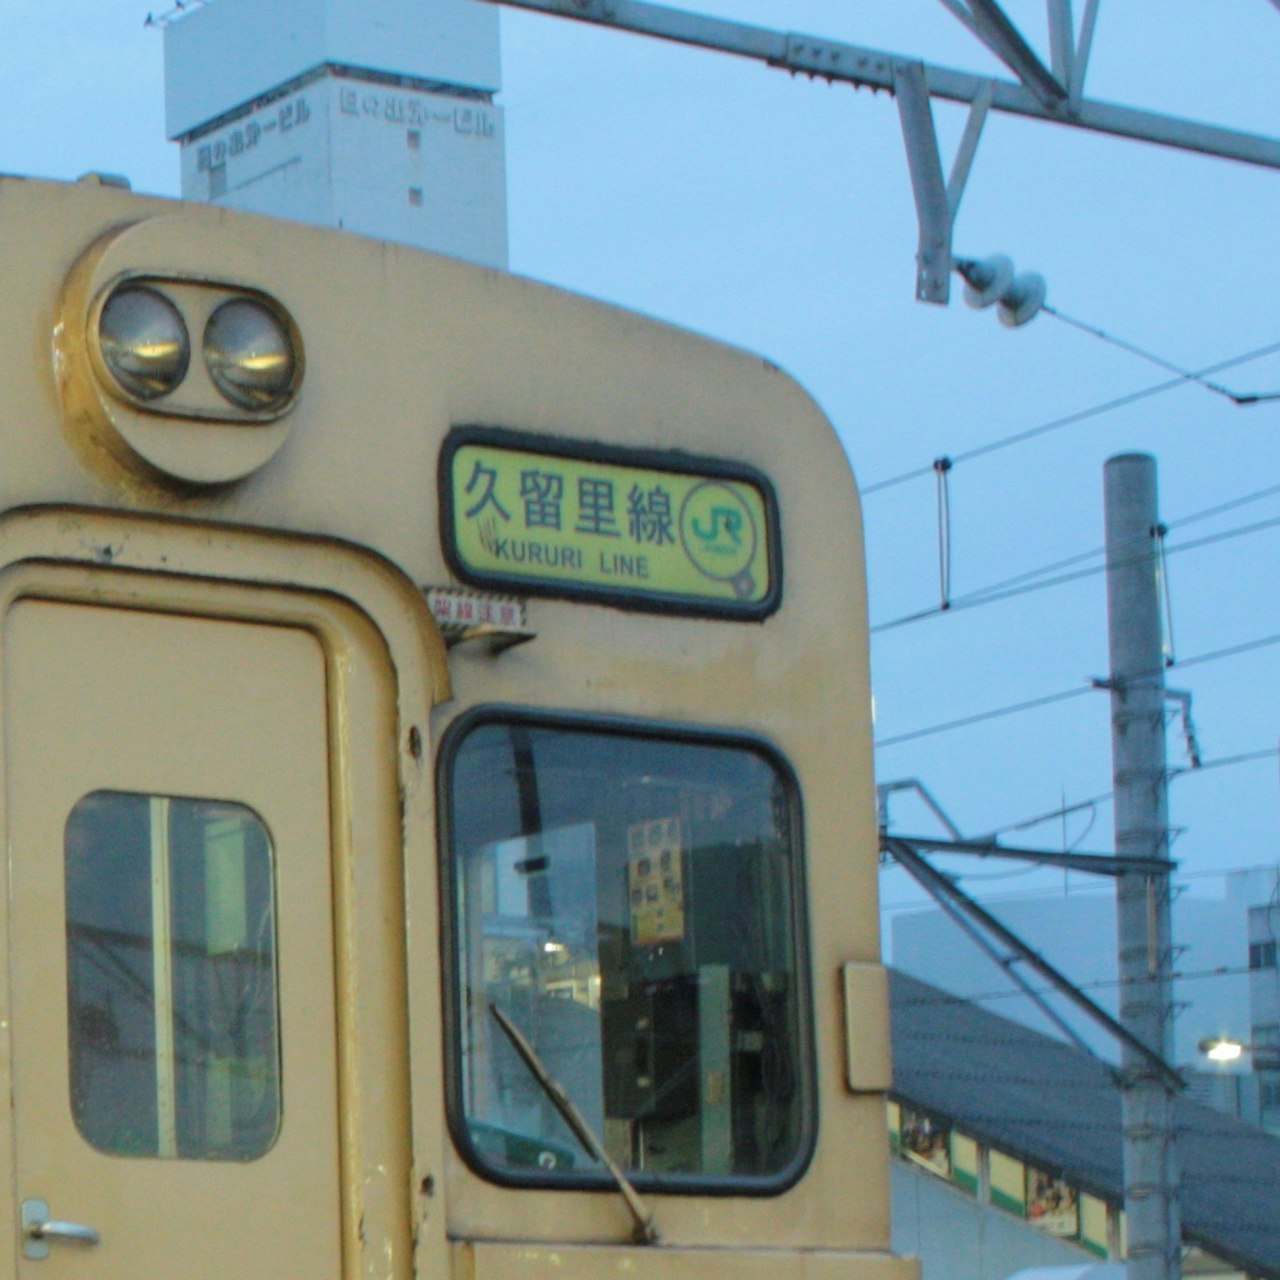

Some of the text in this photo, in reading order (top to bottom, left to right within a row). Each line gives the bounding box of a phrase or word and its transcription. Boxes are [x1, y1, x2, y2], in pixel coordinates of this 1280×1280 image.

[464, 459, 676, 546] 久留里線
[691, 505, 744, 545] JR
[495, 537, 650, 579] KURURI LINE
